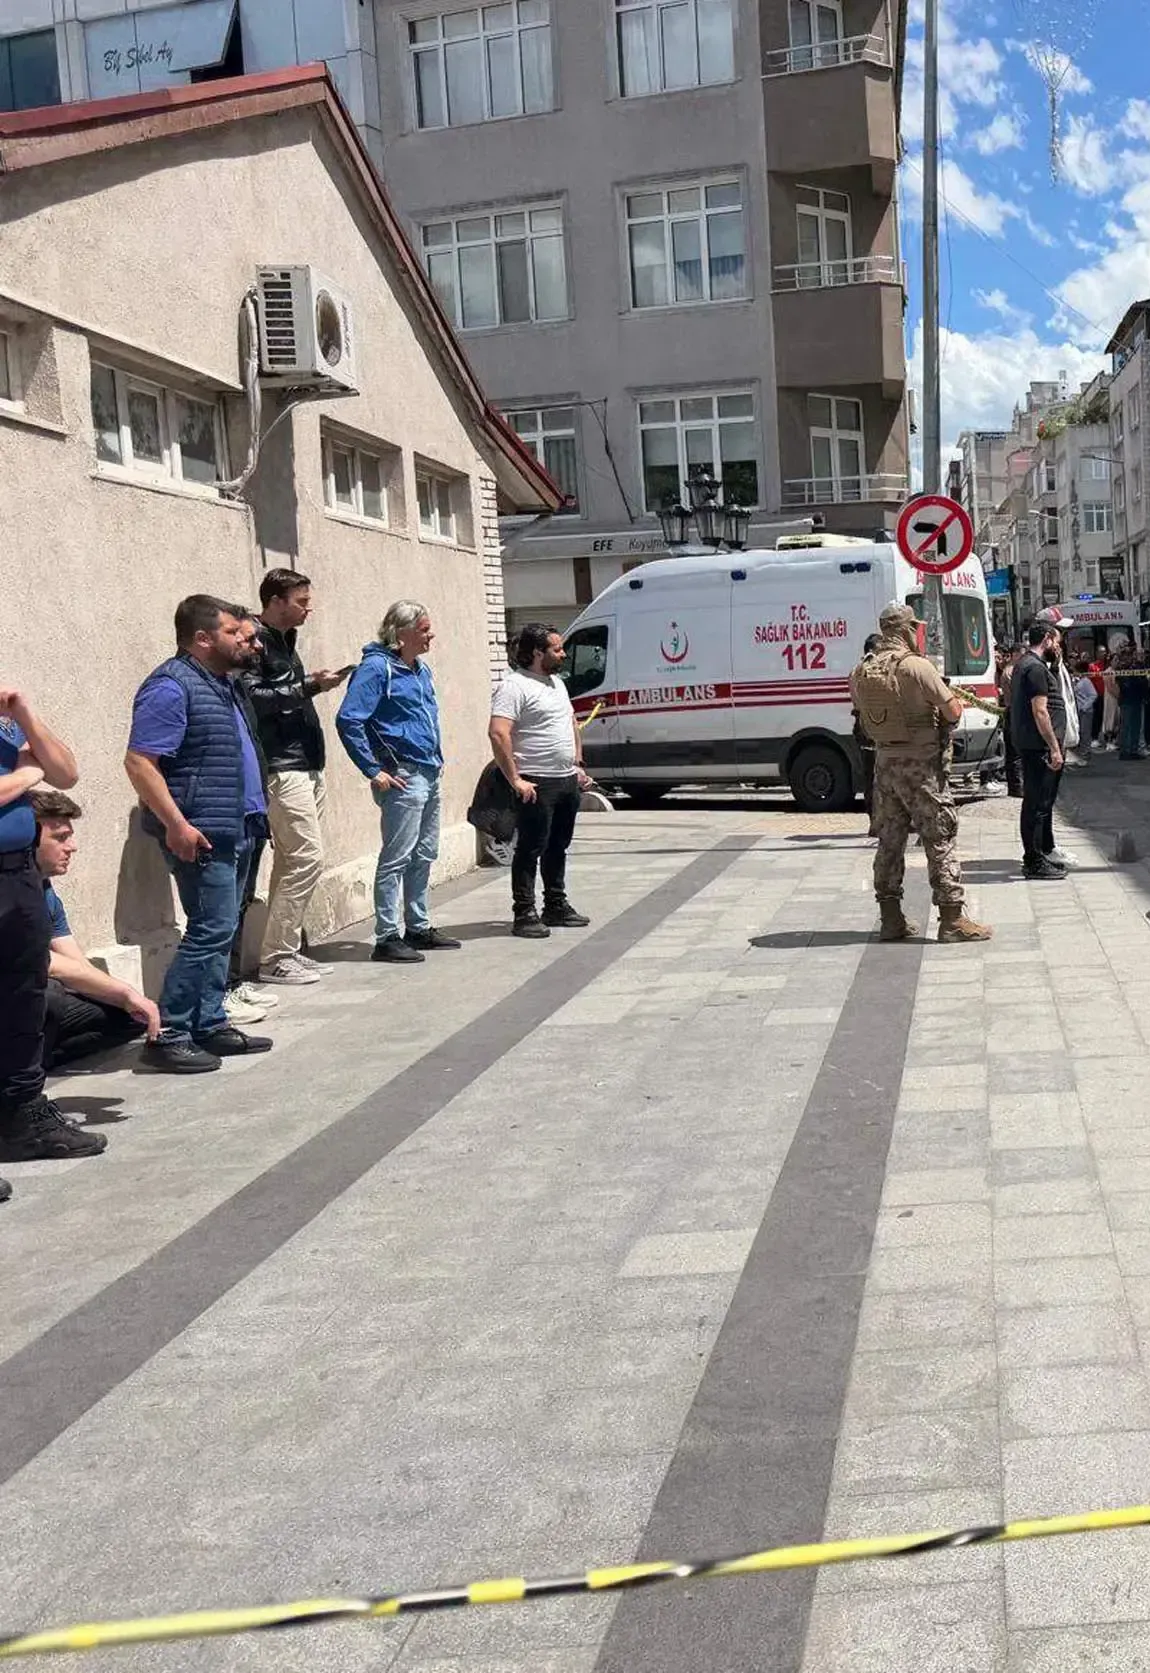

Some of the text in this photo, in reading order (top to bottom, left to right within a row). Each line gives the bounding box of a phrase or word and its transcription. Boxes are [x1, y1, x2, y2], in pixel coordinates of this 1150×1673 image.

[593, 539, 613, 551] EFE
[916, 569, 977, 589] AULANS
[790, 605, 810, 622] T.C.
[754, 619, 848, 643] SAĞLIK BAKANLIĞI
[781, 642, 827, 671] 112
[627, 684, 717, 705] AMBULANS
